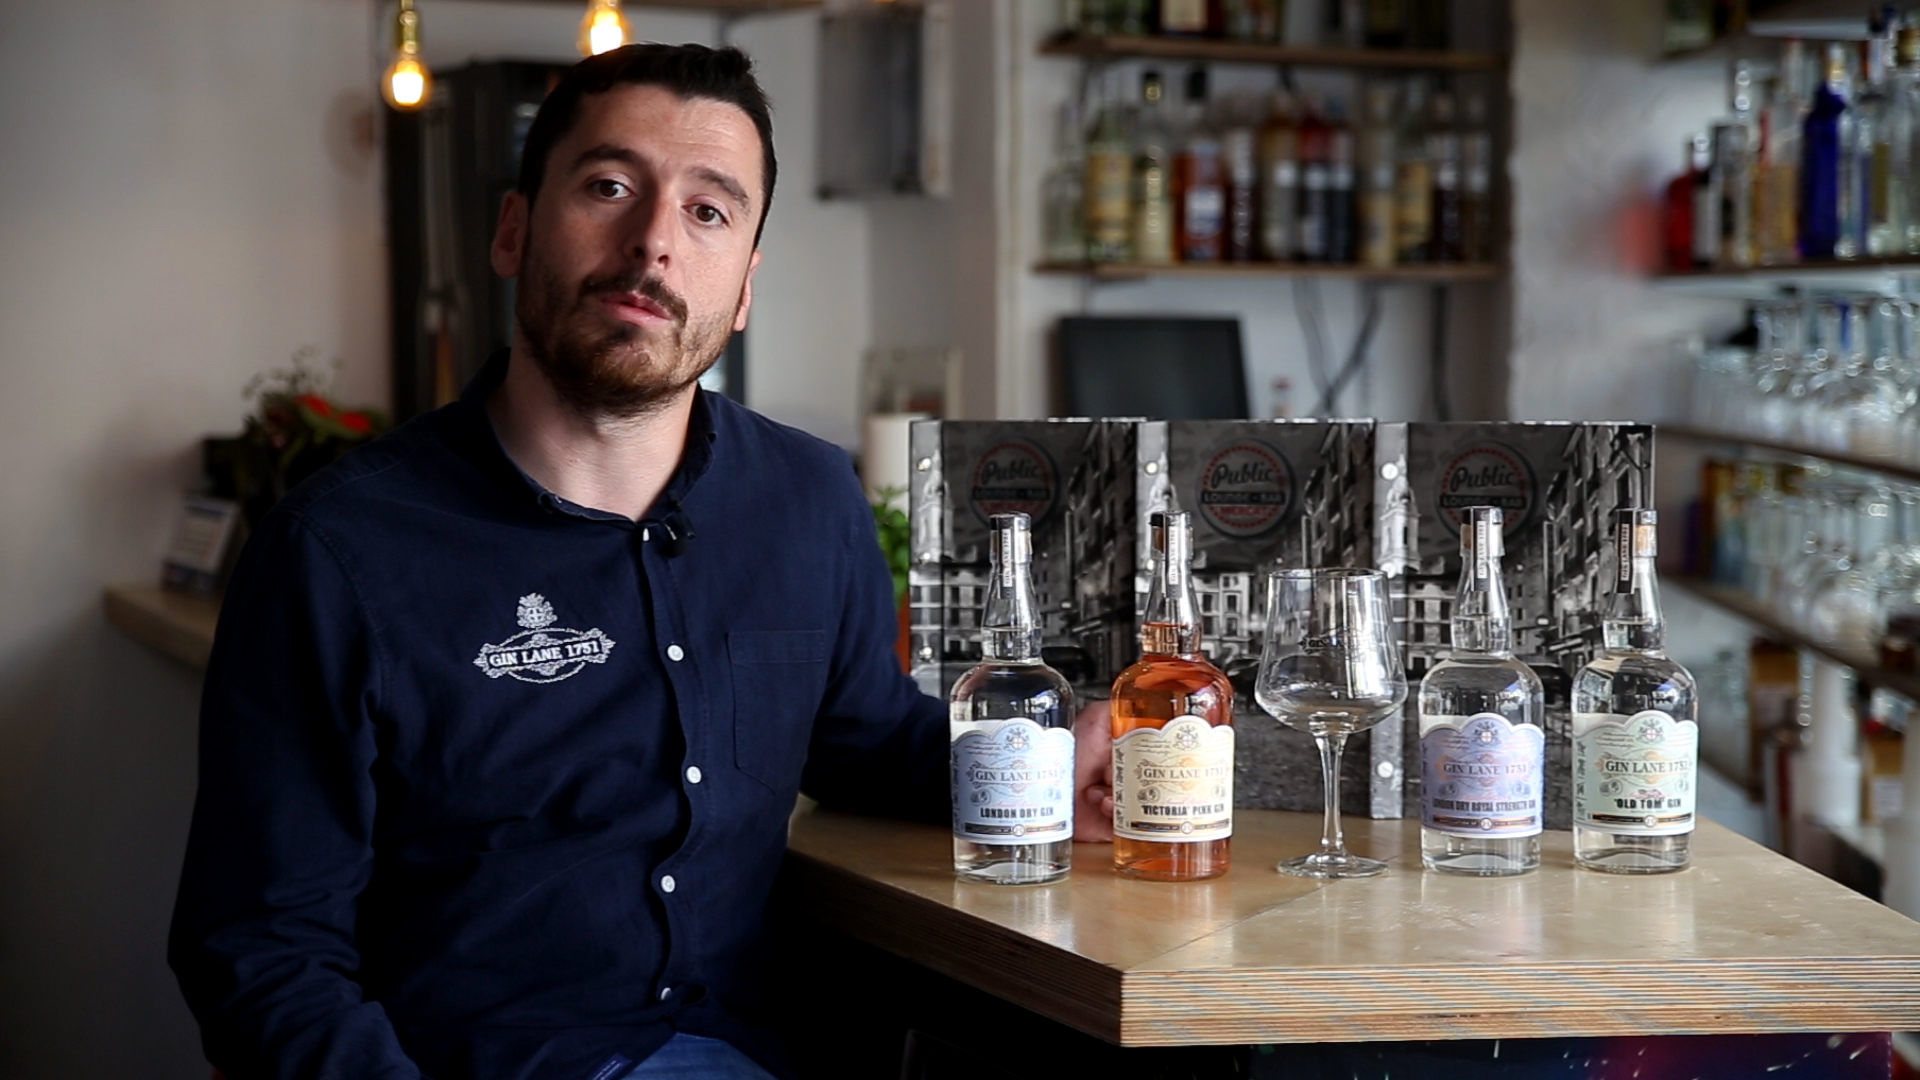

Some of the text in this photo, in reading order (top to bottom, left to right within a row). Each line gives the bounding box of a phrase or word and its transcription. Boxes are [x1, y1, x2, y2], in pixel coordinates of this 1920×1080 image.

[981, 459, 1039, 486] Public
[1211, 462, 1274, 489] Public
[1450, 465, 1514, 493] Public
[489, 641, 600, 667] GIN LANE 1751
[1443, 763, 1528, 775] GIN LANE 1751
[1605, 760, 1629, 772] GIN
[1632, 762, 1666, 773] LANE
[975, 769, 1059, 781] GIN LANE 1751
[1143, 767, 1166, 779] GIN
[1170, 768, 1200, 779] LANE
[1471, 801, 1494, 812] ROYAL
[1495, 800, 1528, 812] STRENGTH
[1667, 798, 1682, 808] GIN
[979, 806, 1055, 818] LONDON DRY GIN
[1192, 804, 1212, 815] PINK
